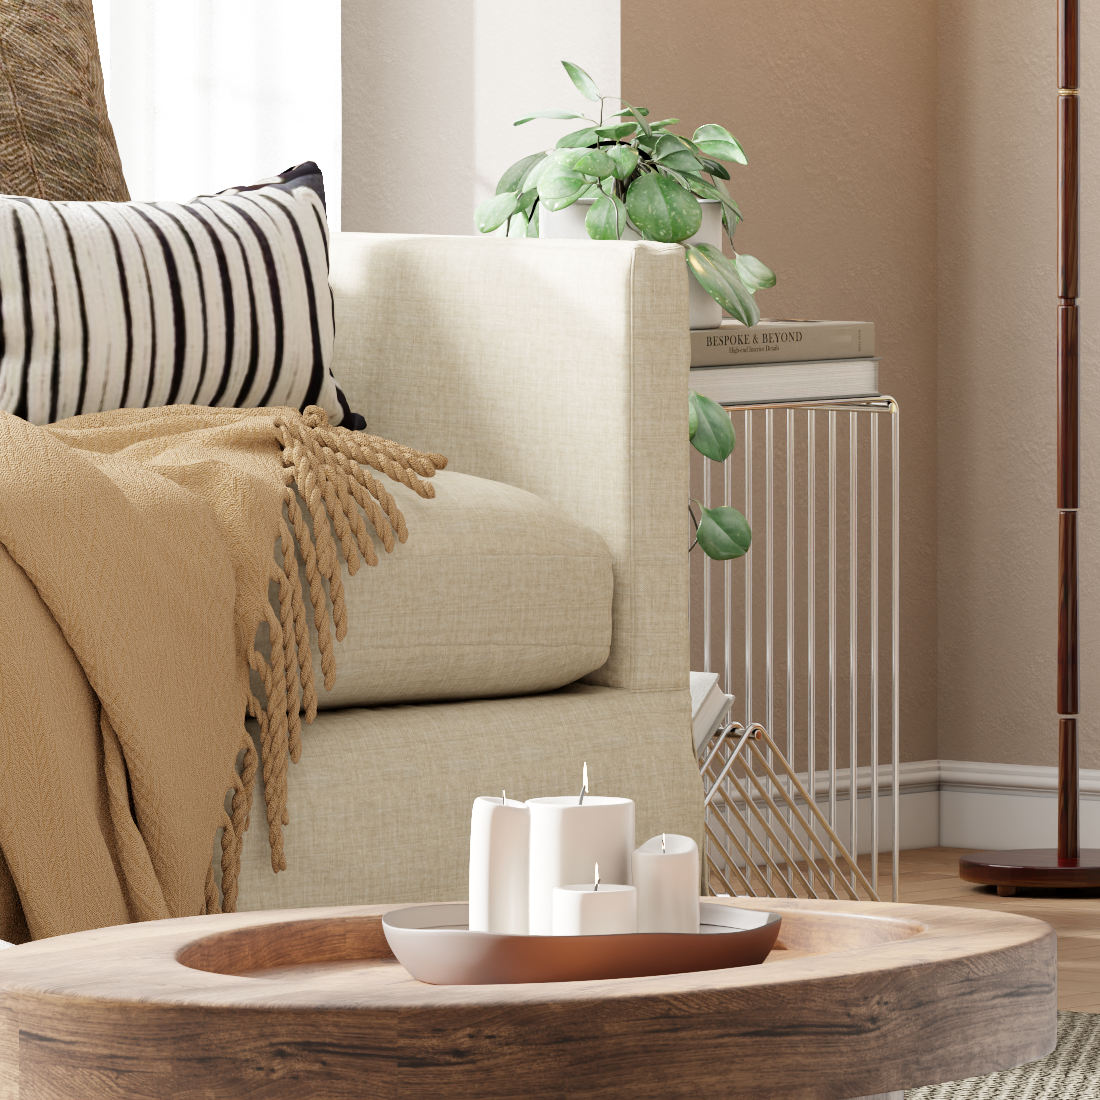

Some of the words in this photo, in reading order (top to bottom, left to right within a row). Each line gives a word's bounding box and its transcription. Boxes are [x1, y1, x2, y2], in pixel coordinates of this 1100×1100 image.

[706, 334, 750, 346] BESPOKE
[752, 334, 759, 345] &
[762, 331, 802, 343] BEYOND
